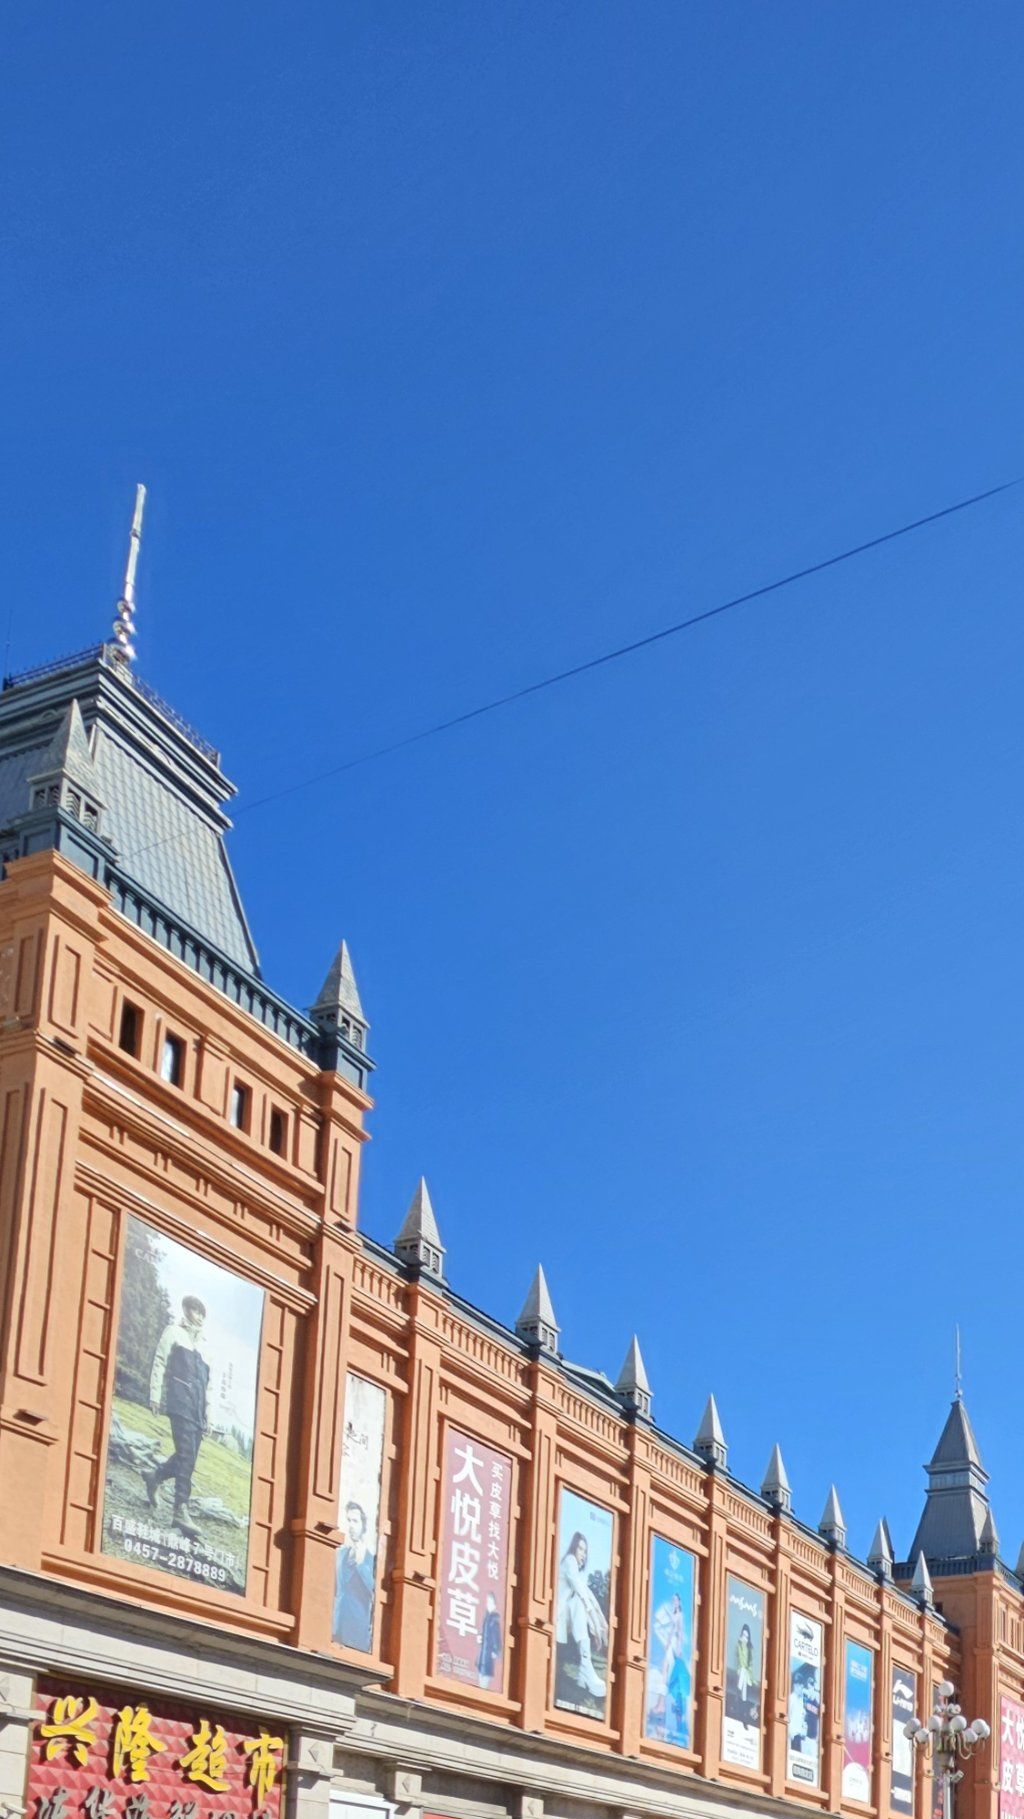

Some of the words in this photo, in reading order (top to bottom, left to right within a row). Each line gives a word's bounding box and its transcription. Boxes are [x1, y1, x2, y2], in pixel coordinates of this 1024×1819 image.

[124, 1538, 226, 1582] 0457-2878889
[487, 1461, 505, 1581] 买皮草找大悦
[41, 1695, 283, 1807] 兴隆超市
